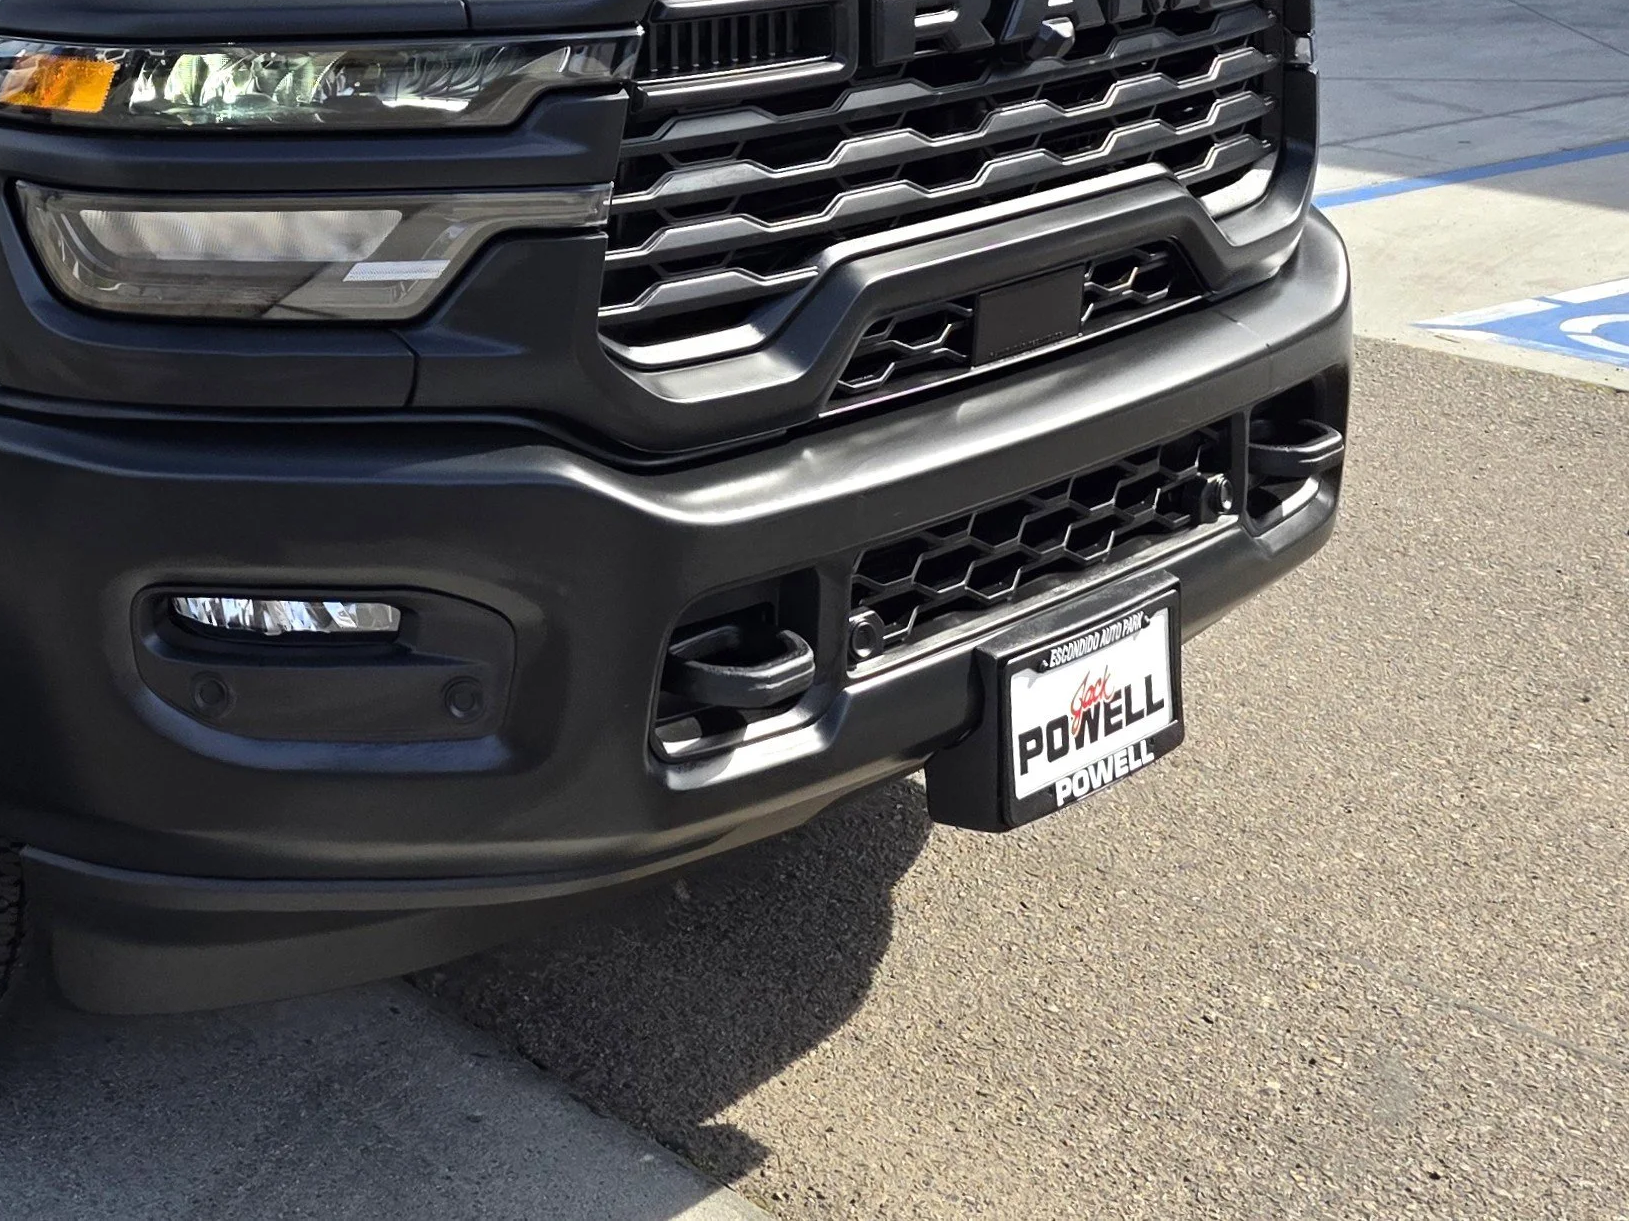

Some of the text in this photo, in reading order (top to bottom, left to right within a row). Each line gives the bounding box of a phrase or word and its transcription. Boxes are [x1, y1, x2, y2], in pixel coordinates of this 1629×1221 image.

[1049, 611, 1144, 667] ESCONDIDO AUTO PARK
[1018, 674, 1165, 776] POWELL
[1071, 665, 1115, 736] Jack
[1055, 739, 1155, 807] POWELL
